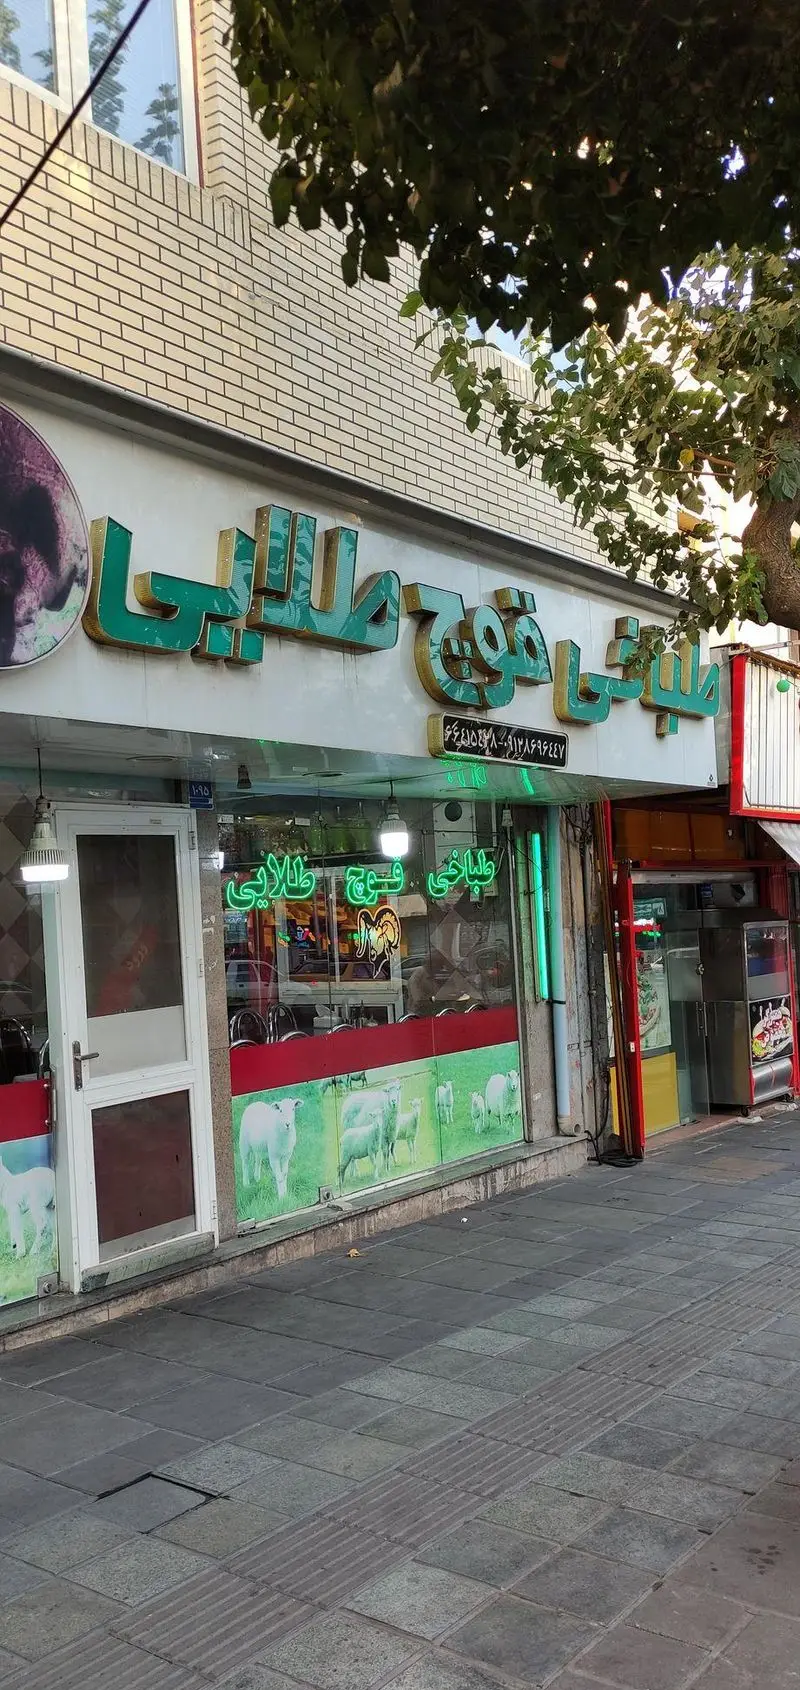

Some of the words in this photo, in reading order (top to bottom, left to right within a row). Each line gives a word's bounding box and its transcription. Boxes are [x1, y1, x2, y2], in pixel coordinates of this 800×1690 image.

[83, 504, 401, 664] طلایی
[402, 583, 553, 709] قوچ
[553, 616, 720, 736] طباخی
[226, 852, 316, 911] طلایی
[428, 849, 495, 897] طباخی
